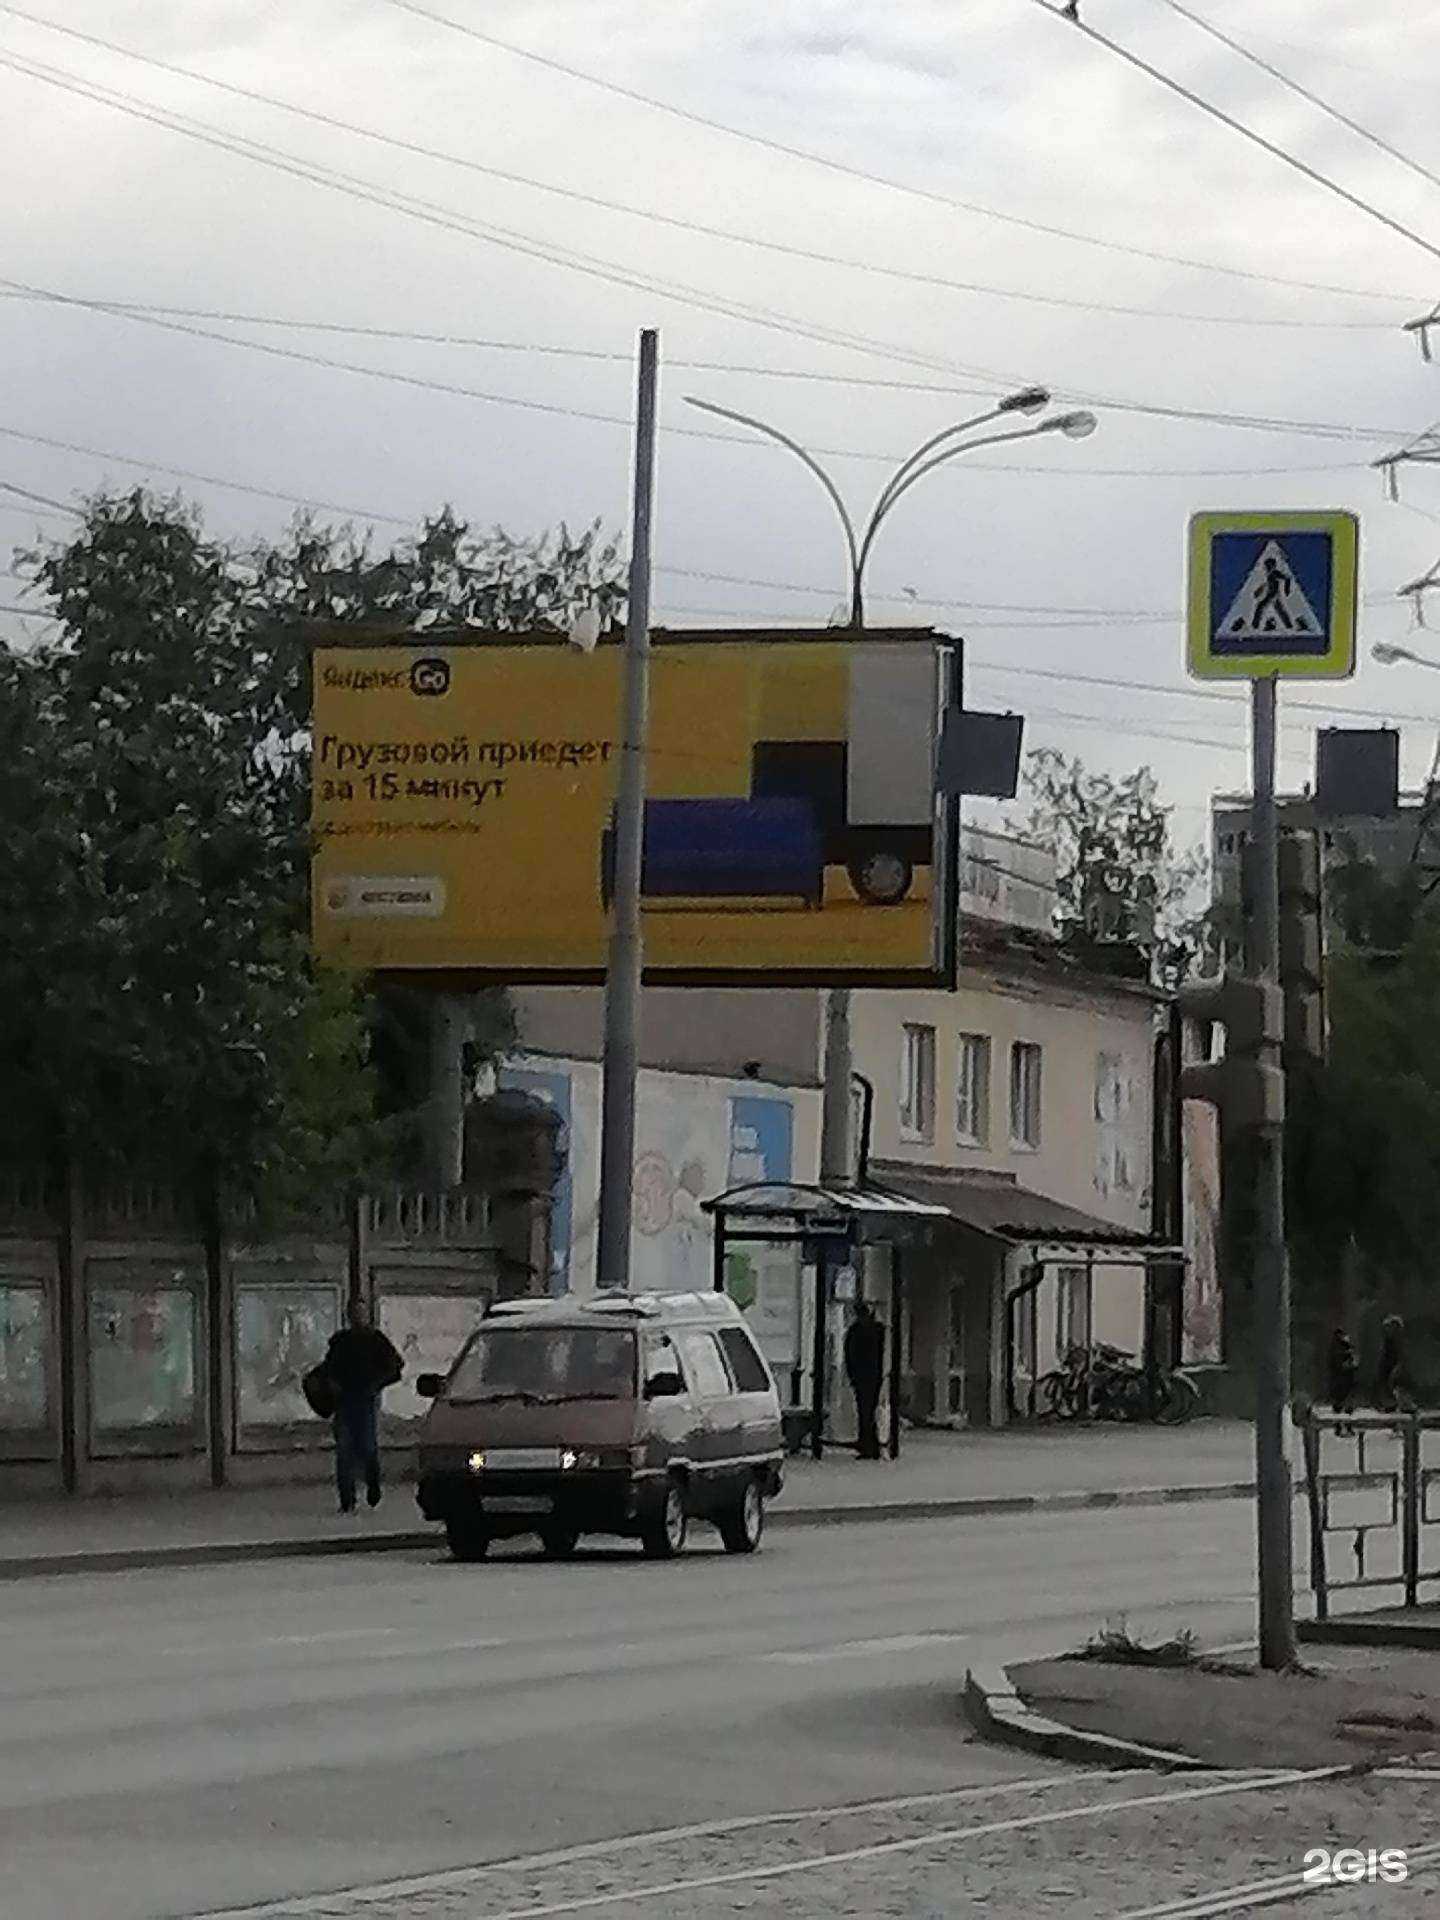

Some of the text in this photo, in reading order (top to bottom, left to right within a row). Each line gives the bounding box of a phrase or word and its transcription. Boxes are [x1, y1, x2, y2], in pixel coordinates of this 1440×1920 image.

[320, 736, 612, 770] Грузовой приедет
[321, 772, 507, 805] за 15 минут
